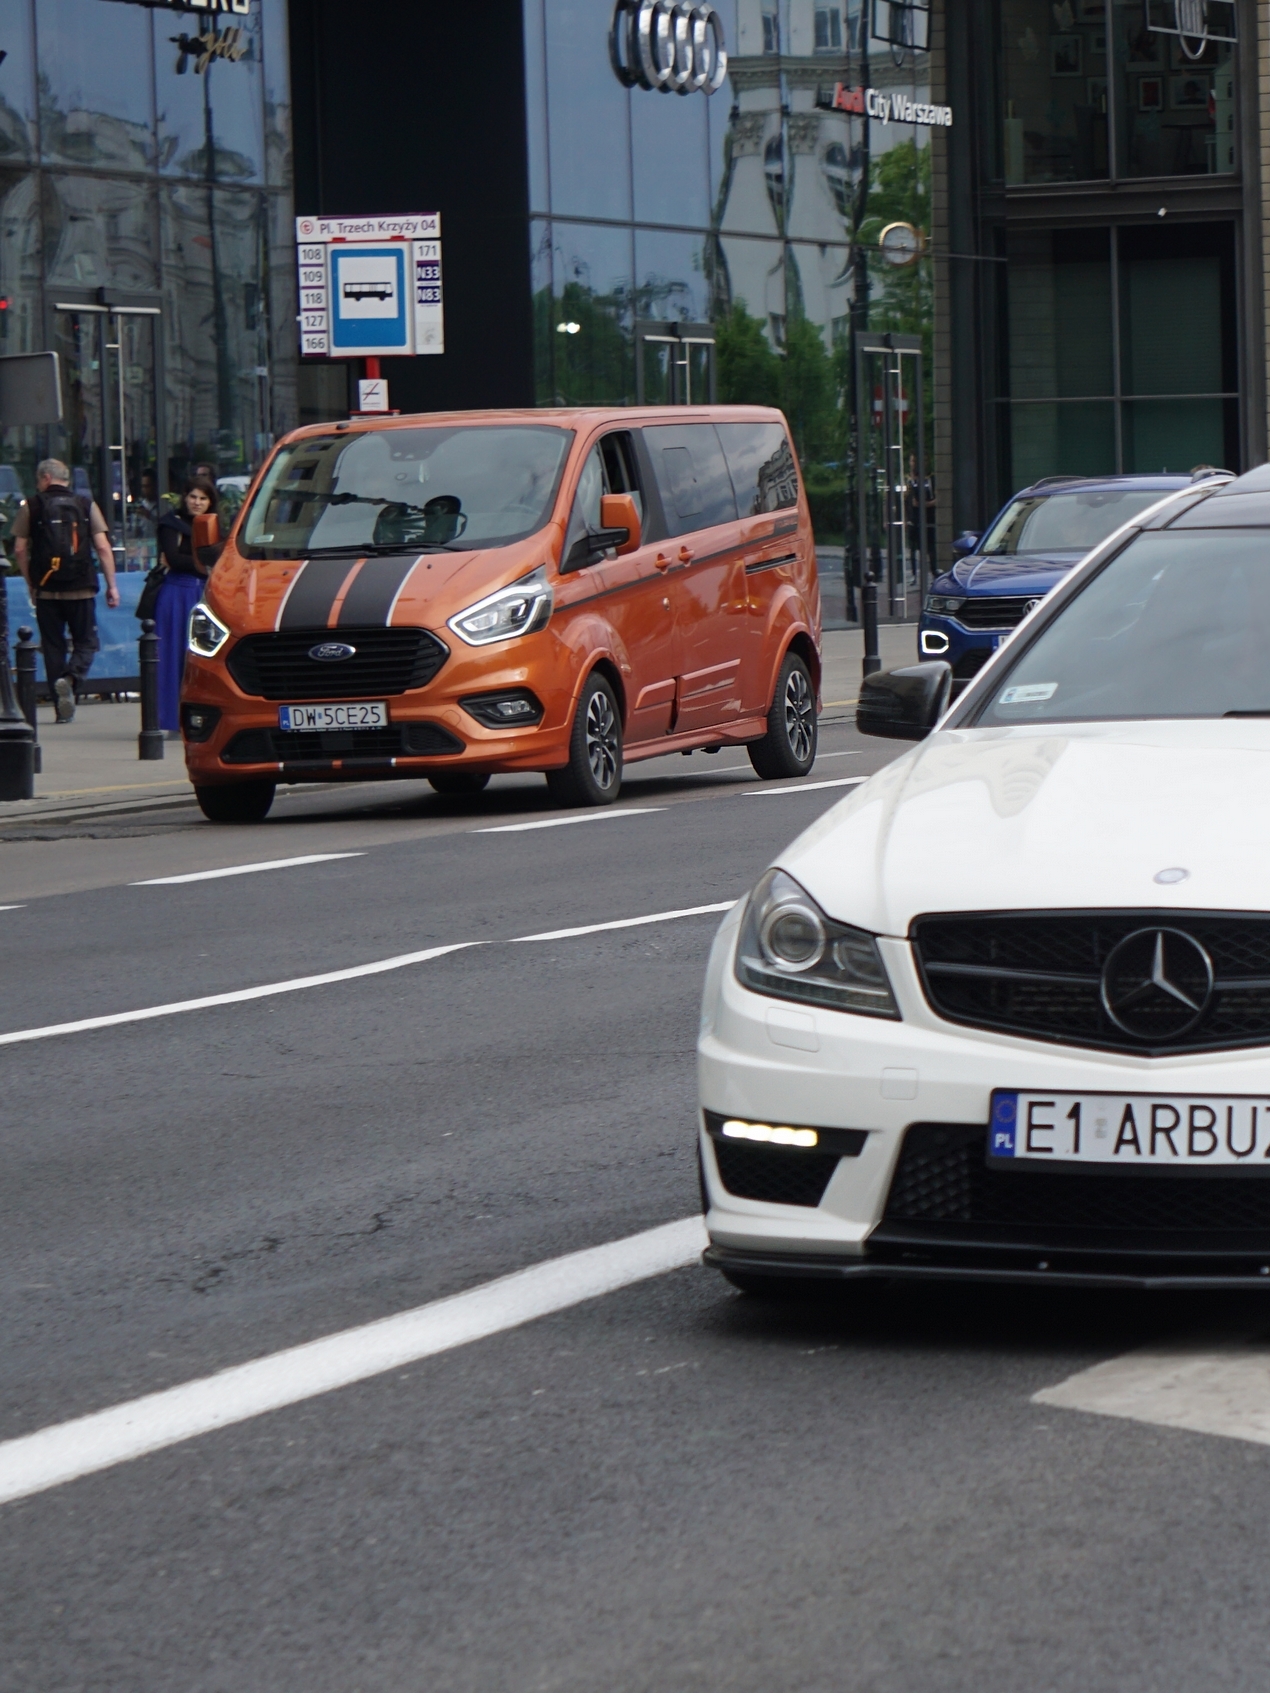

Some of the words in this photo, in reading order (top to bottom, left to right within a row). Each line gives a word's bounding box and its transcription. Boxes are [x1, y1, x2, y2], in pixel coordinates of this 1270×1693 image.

[865, 88, 891, 125] City
[892, 93, 953, 126] Warszawa
[320, 223, 334, 234] Pl.
[337, 221, 375, 234] Trzech
[378, 220, 418, 233] Krzyży
[421, 219, 436, 231] 04
[302, 249, 322, 260] 108
[418, 245, 437, 256] 171
[303, 271, 323, 282] 109
[417, 266, 440, 279] N33
[305, 293, 323, 304] 118
[304, 315, 324, 327] 127
[305, 338, 325, 349] 166
[317, 645, 344, 657] Ford
[293, 708, 317, 727] DW
[324, 705, 381, 725] 5CE25
[1025, 1101, 1083, 1154] E1
[995, 1133, 1013, 1149] PL
